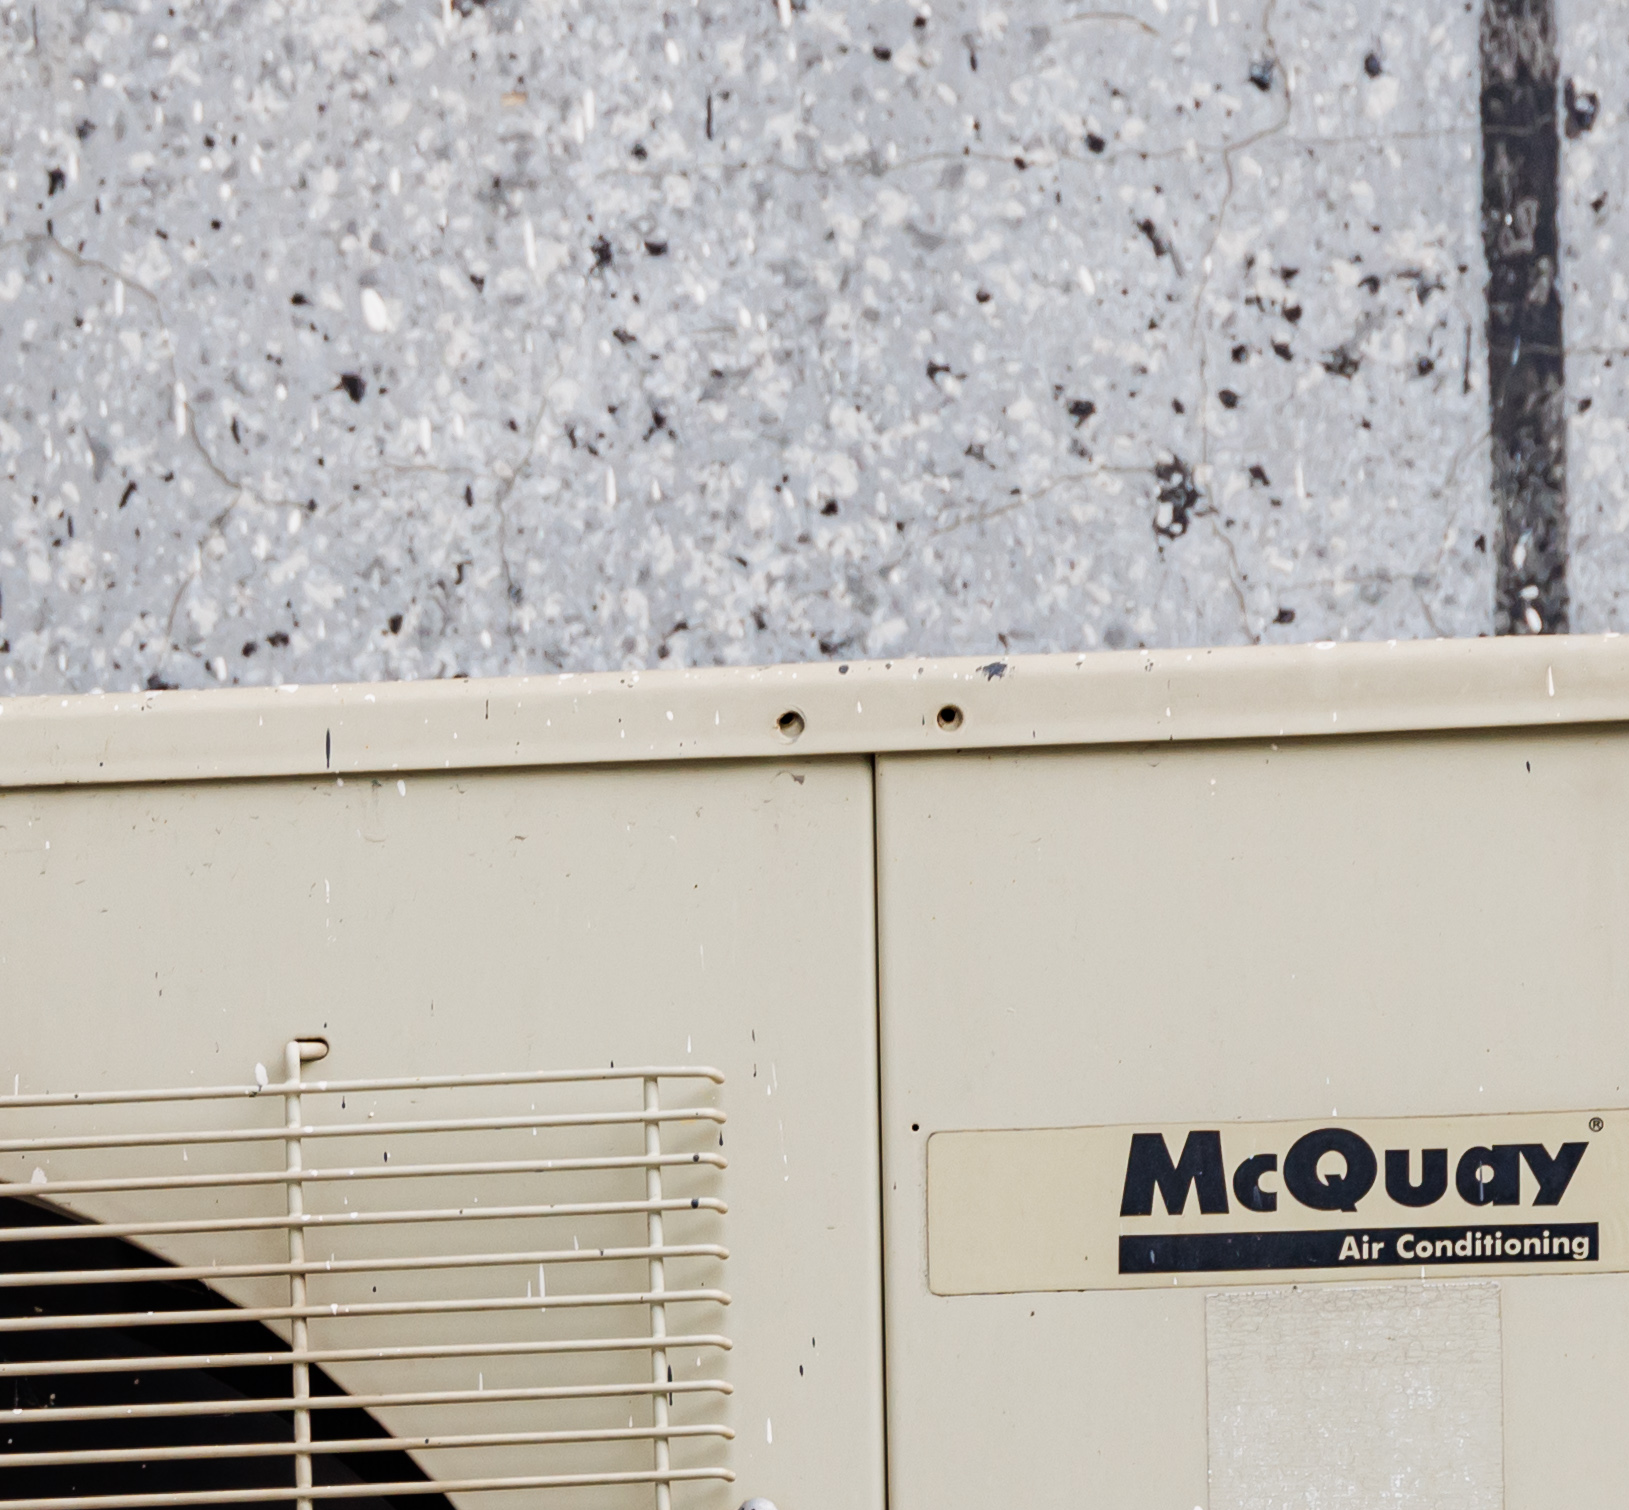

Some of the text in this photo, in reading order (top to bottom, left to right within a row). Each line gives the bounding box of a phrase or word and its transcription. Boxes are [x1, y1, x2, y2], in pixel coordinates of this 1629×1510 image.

[1119, 1127, 1589, 1217] McQuay
[1338, 1230, 1590, 1261] Air Conditioning
